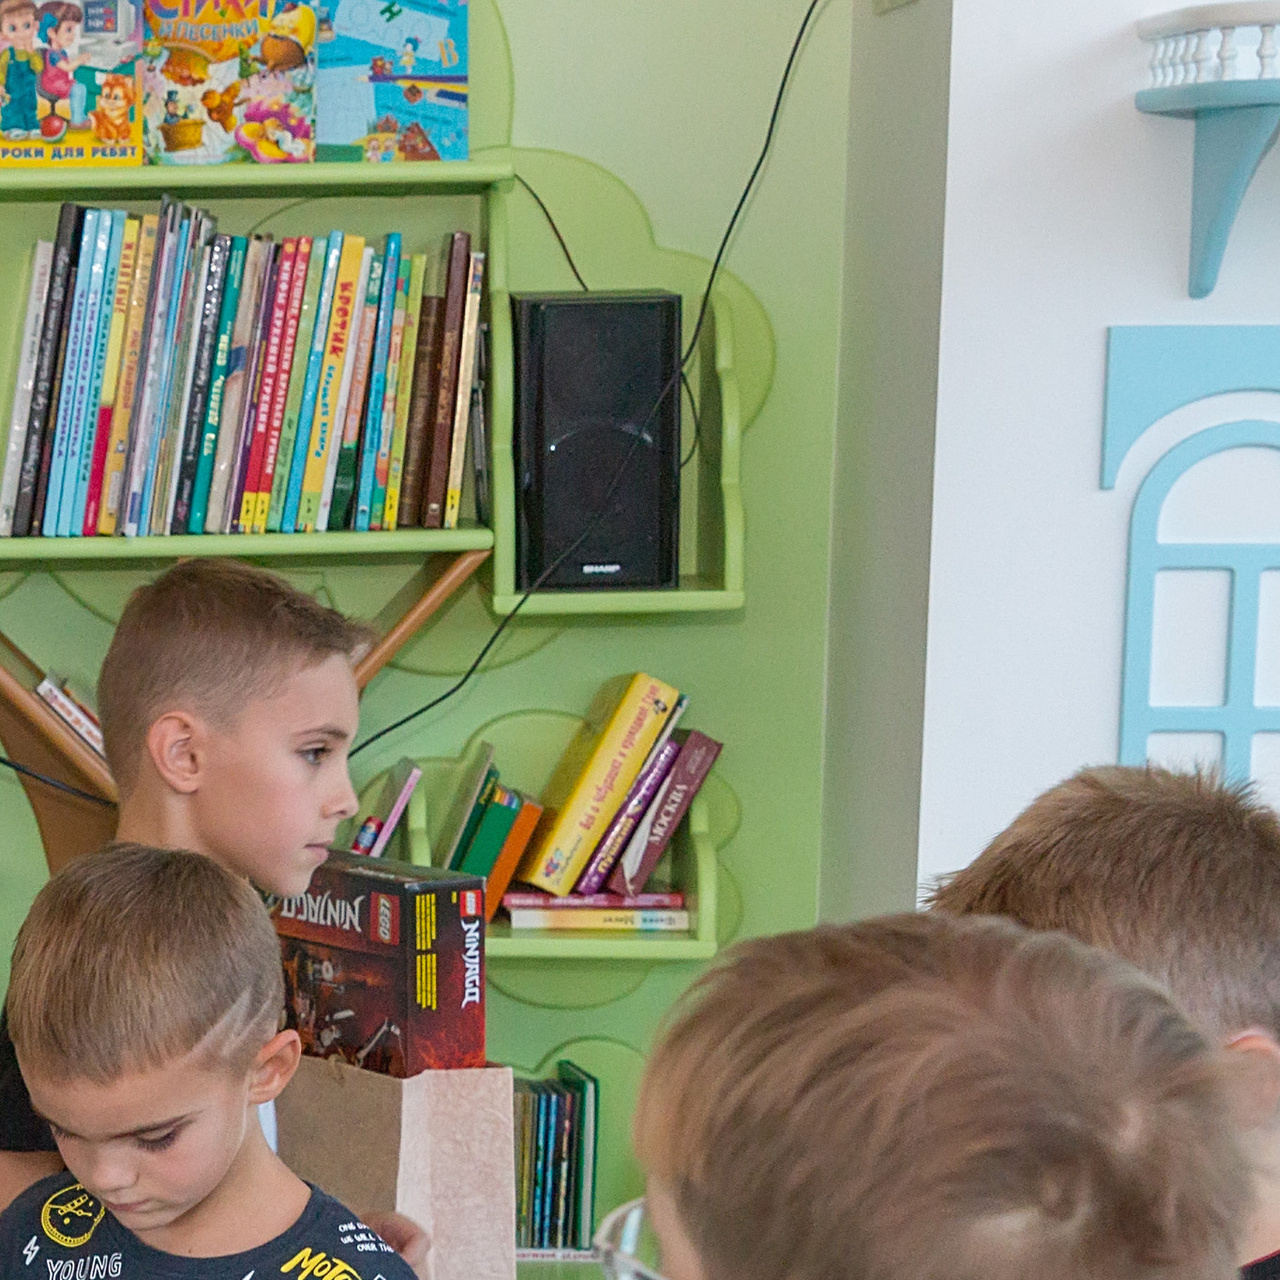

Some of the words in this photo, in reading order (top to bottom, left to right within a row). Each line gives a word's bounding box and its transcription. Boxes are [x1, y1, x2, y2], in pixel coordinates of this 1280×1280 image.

[176, 19, 259, 42] ПЕСЕНКИ
[51, 147, 84, 160] ДЛЯ
[91, 146, 137, 158] РЕБЯТ
[276, 260, 290, 304] МИФЫ
[289, 260, 305, 315] ЛУЧШИЕ
[266, 308, 284, 373] ДРЕВНЕЙ
[281, 317, 297, 369] СКАЗКИ
[328, 279, 353, 359] КРОТИК
[55, 384, 73, 458] УЧИМСЯ
[65, 288, 86, 380] ГОВОРИТЬ
[80, 385, 100, 481] РАЗВИВАЕМ
[94, 312, 110, 380] УСТНУЮ
[104, 266, 116, 305] РЕЧЬ
[272, 372, 287, 427] БРАТЬЕВ
[69, 384, 86, 458] УЧИМСЯ
[256, 377, 273, 432] ГРЕЦИИ
[202, 431, 215, 455] ЧТО
[264, 430, 279, 474] ГРИММ
[646, 780, 689, 846] МОСКВА
[460, 918, 480, 1010] NINJAGO
